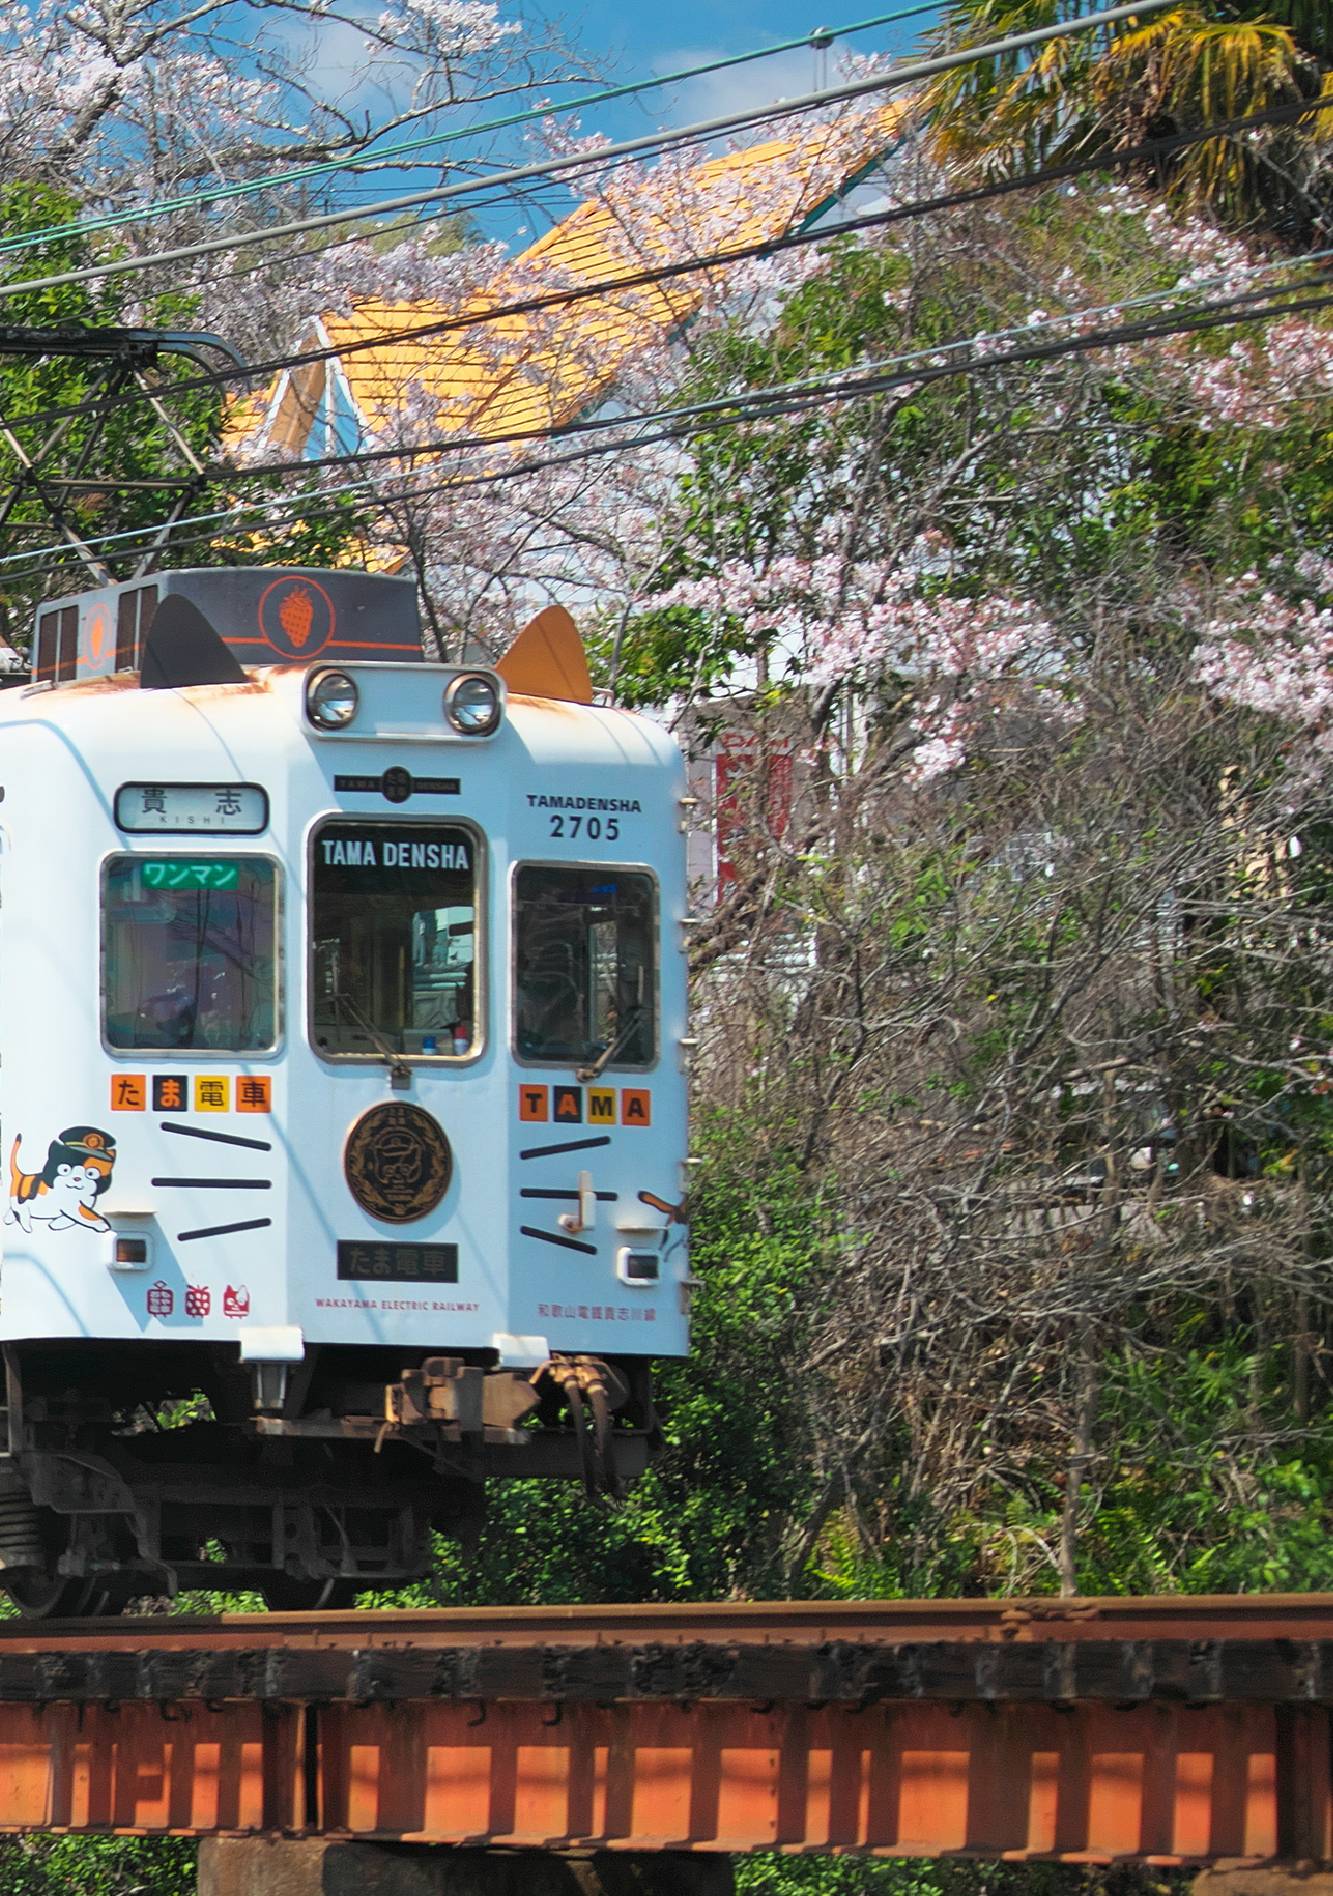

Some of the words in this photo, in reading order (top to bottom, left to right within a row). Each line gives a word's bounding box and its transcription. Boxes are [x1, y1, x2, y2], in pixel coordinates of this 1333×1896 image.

[141, 788, 242, 816] 貴志
[526, 794, 642, 813] TAMADENSHA
[159, 816, 225, 824] KISHI
[550, 815, 619, 841] 2705
[322, 840, 377, 866] TAMA
[383, 843, 469, 870] DENSHA
[144, 863, 235, 886] ワンマン
[118, 1079, 266, 1107] たま電車
[525, 1093, 645, 1118] TAMA
[348, 1247, 446, 1275] たま電車
[315, 1298, 377, 1308] WAKAYAMA
[381, 1300, 429, 1310] ELECTRIC
[432, 1302, 480, 1312] RAILWAY
